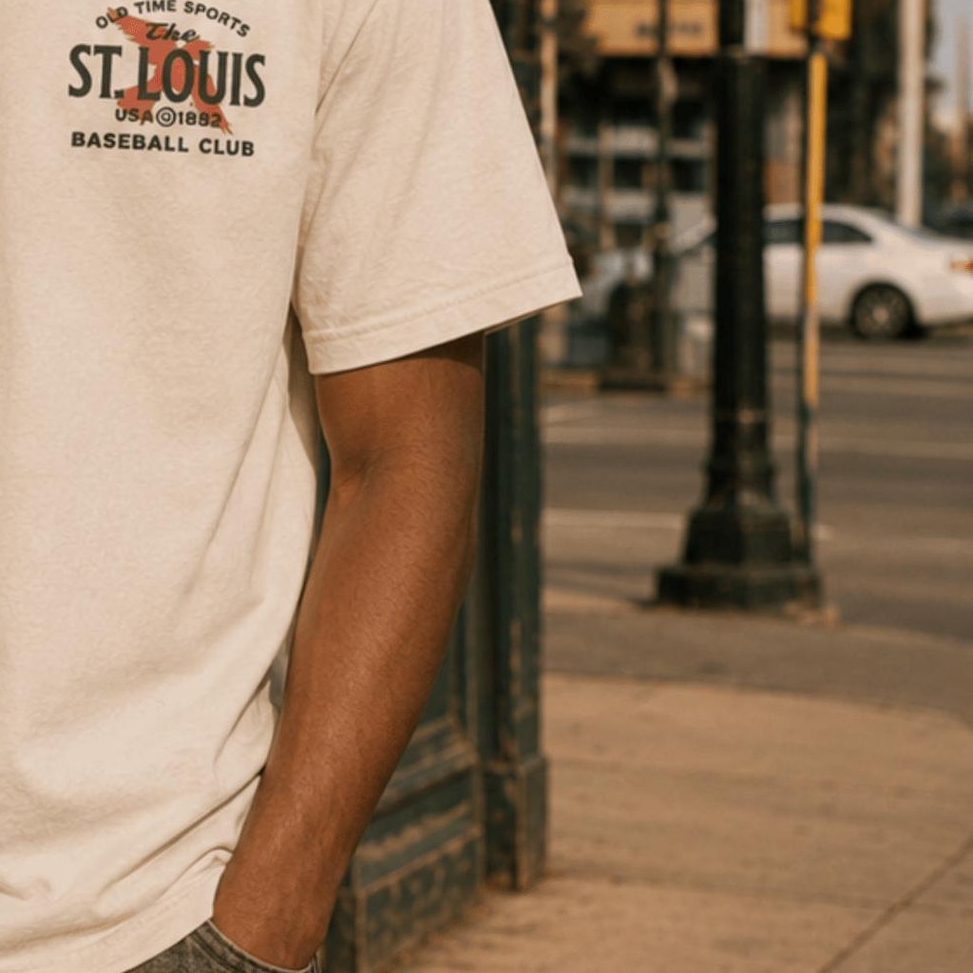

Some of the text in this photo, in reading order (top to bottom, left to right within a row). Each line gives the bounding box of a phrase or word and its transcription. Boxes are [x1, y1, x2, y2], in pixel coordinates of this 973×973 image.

[95, 0, 250, 37] OLD TIME SPORTS
[145, 22, 200, 42] The
[68, 43, 265, 107] ST. LOUIS
[71, 131, 255, 157] BASEBALL CLUB
